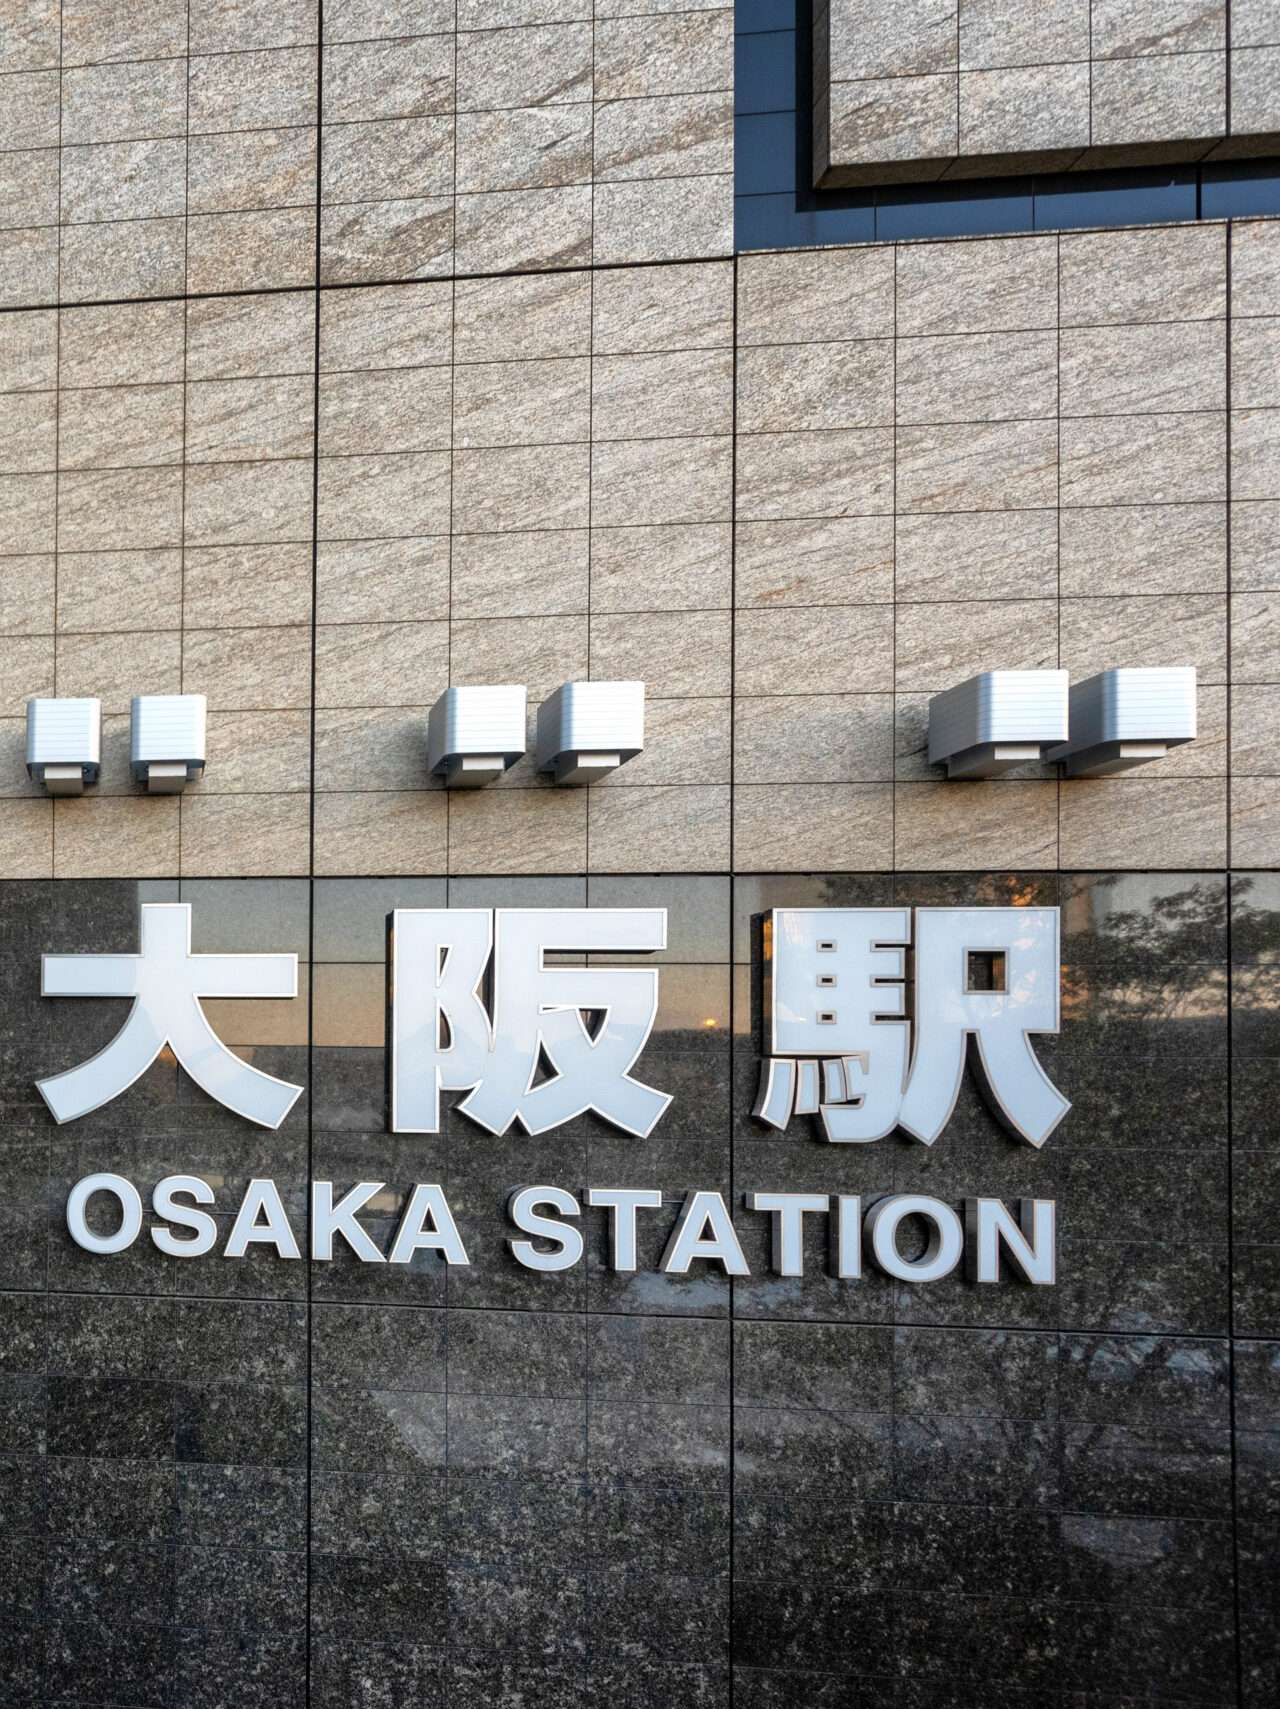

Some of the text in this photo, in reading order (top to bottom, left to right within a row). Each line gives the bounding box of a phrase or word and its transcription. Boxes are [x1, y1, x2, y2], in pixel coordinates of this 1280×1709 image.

[35, 902, 1073, 1149] 大阪駅
[66, 1172, 1056, 1285] OSAKA STATION
